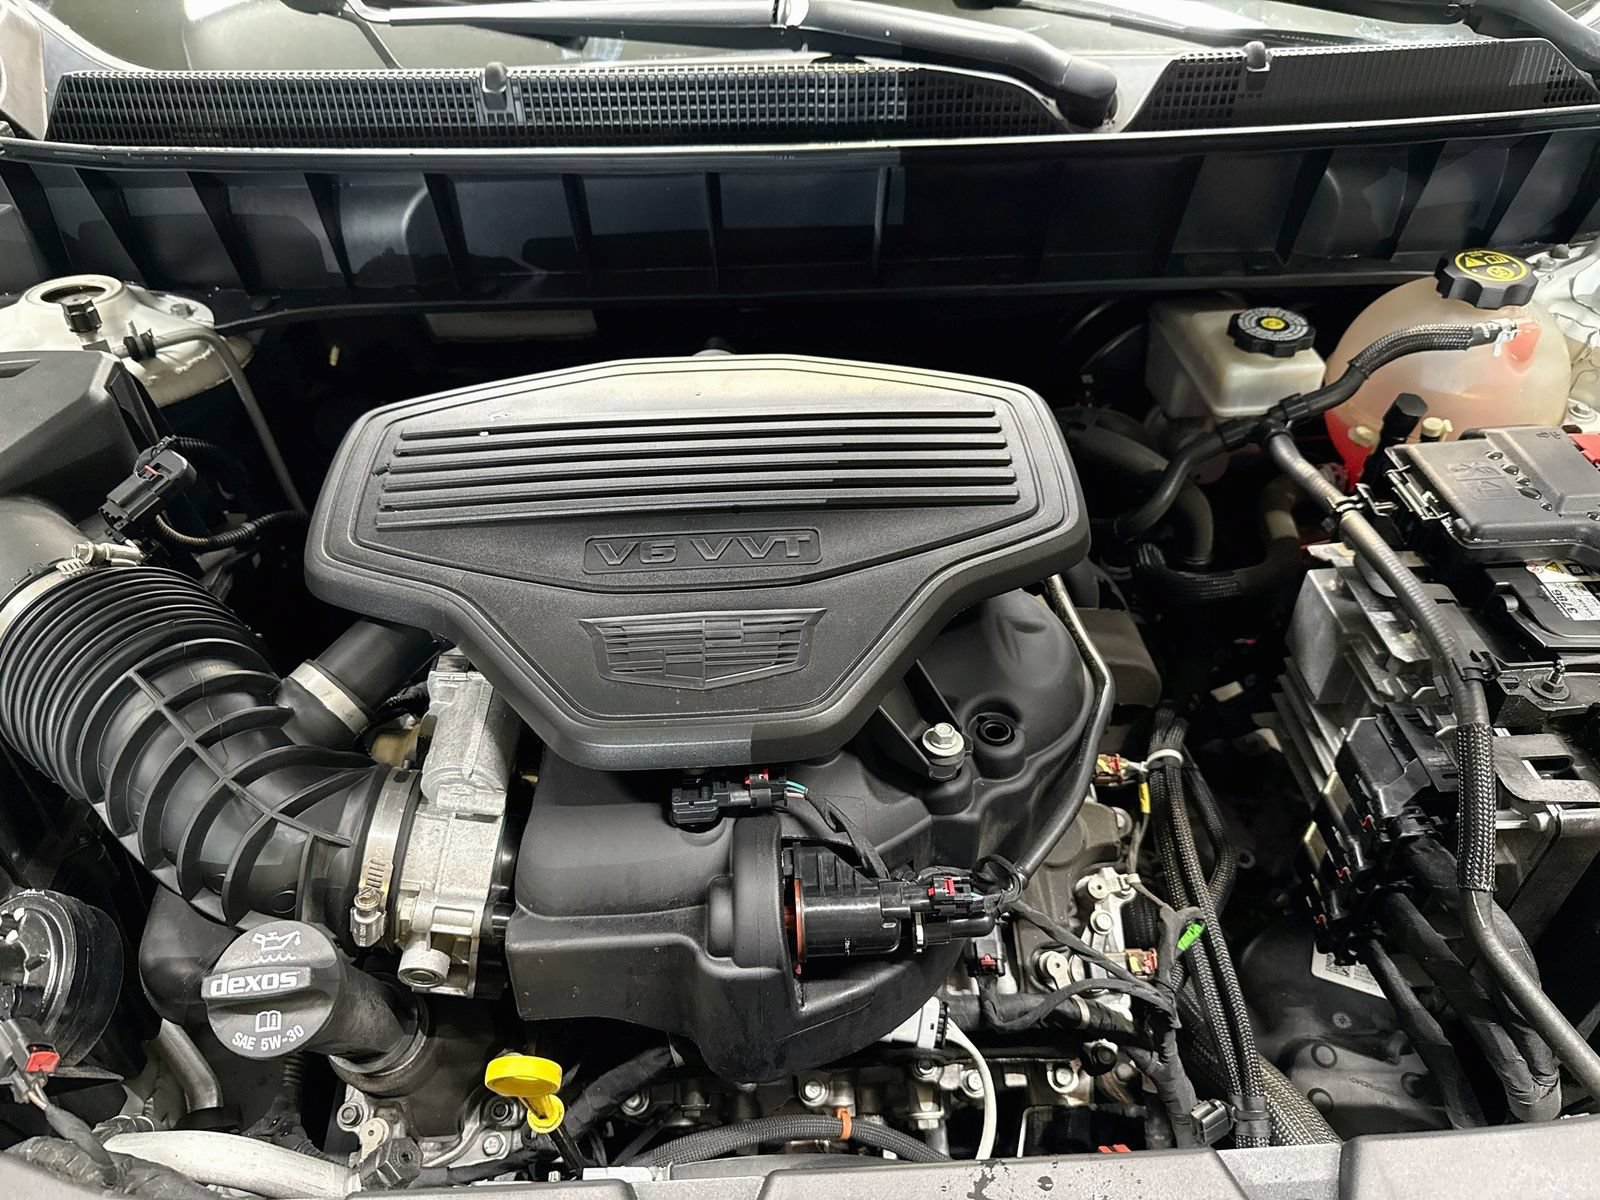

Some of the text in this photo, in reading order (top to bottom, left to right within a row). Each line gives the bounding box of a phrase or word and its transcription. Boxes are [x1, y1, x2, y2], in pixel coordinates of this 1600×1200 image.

[595, 535, 810, 565] V6 VVT
[210, 972, 299, 997] dexos
[232, 1024, 305, 1052] SAE 5W-30
